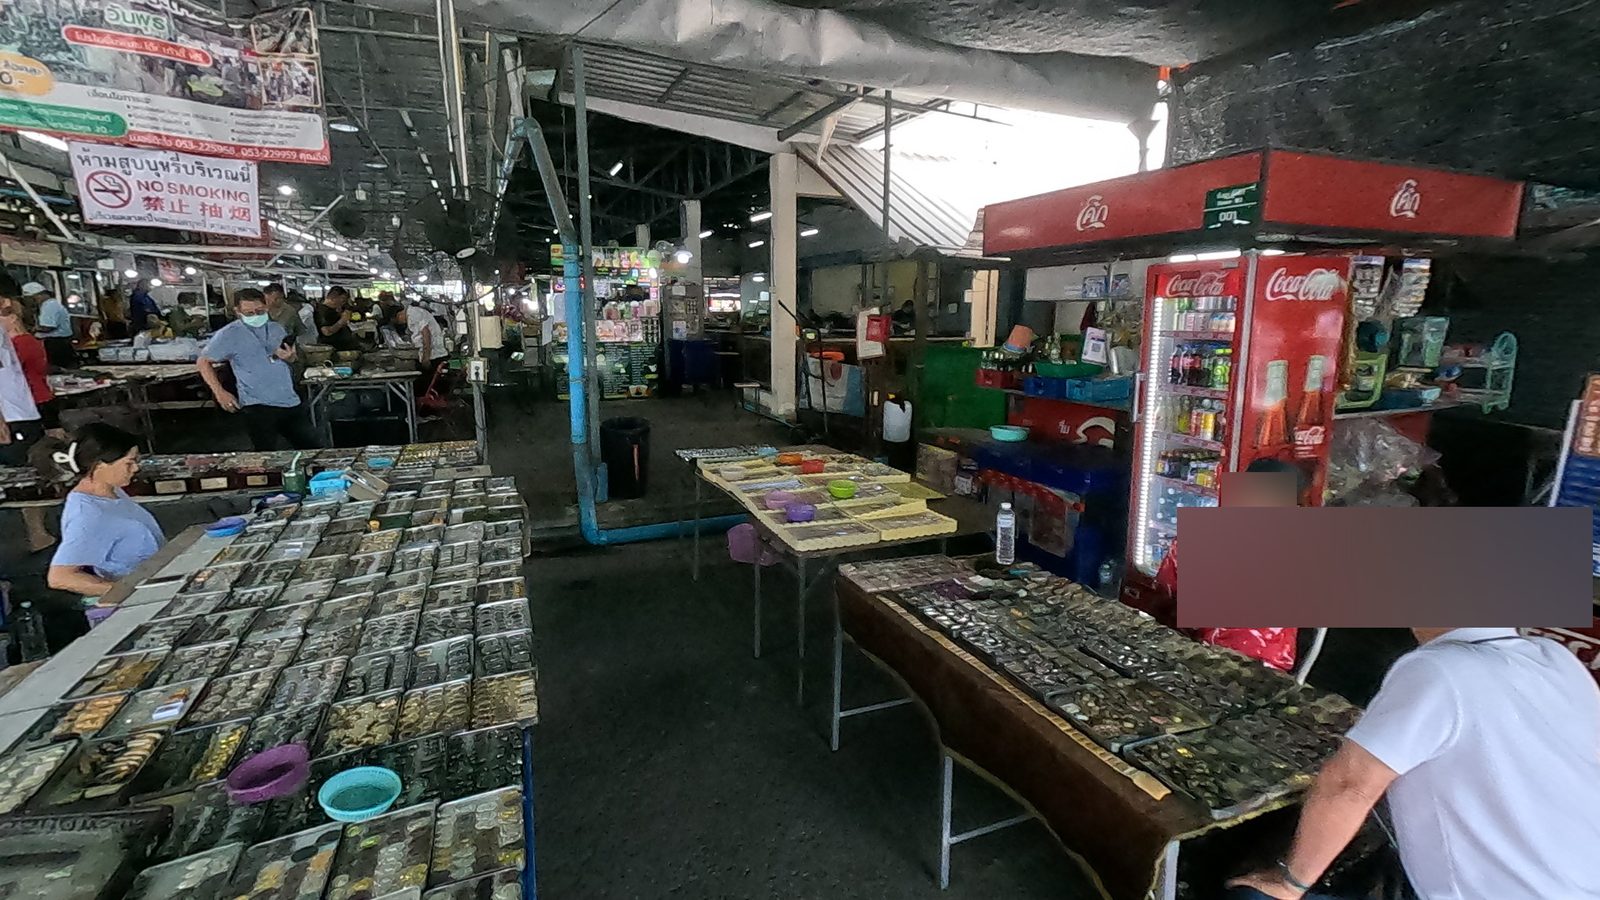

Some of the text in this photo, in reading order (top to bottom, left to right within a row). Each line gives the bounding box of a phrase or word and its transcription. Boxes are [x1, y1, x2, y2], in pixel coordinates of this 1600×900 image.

[76, 148, 252, 183] ห้ามสูบบุหรี่บริเวณนี้
[137, 179, 250, 203] NO SMOKING
